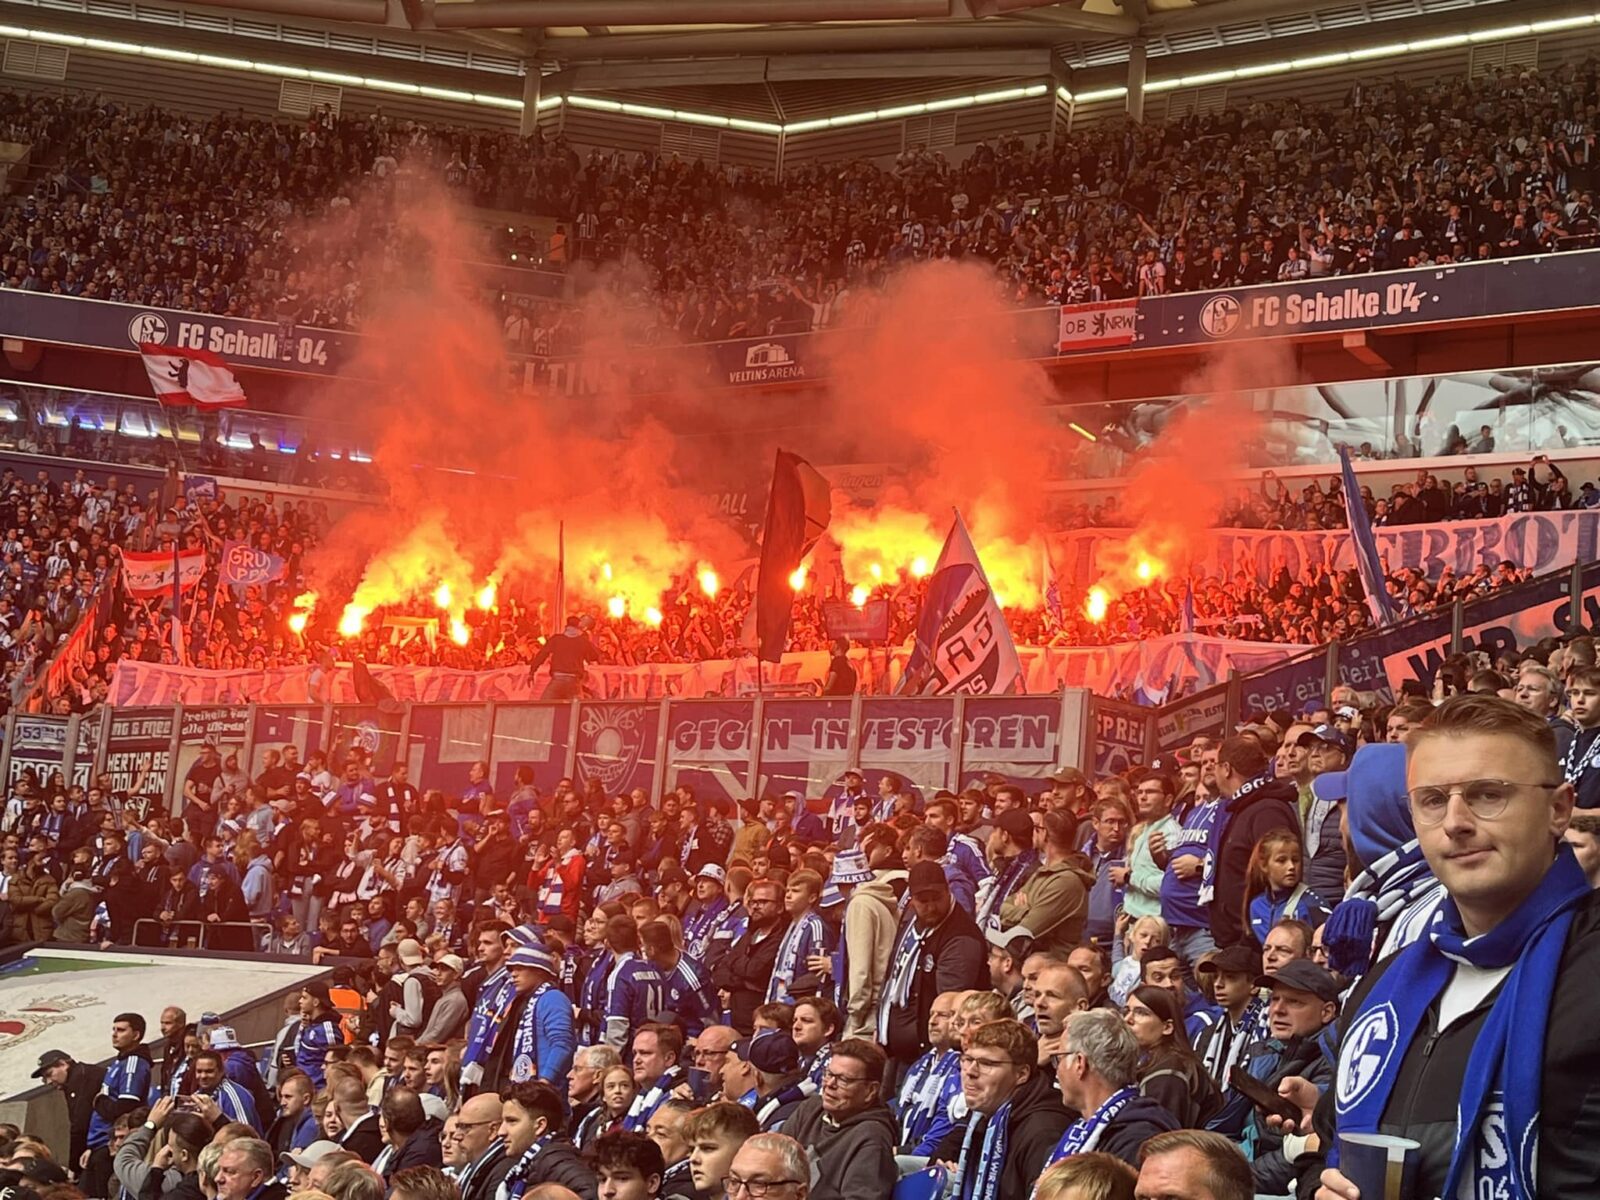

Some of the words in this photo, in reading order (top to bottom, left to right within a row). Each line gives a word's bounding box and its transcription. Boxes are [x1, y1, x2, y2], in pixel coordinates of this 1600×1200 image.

[1251, 295, 1280, 328] FC
[1285, 288, 1380, 325] Schalke
[1386, 282, 1421, 315] 04
[1065, 319, 1087, 335] OB
[1105, 315, 1134, 331] NRW
[177, 321, 204, 351] FC
[296, 337, 328, 366] 04
[729, 369, 768, 383] VELTINS
[767, 366, 805, 380] ARENA
[229, 547, 266, 569] GRU
[1247, 686, 1290, 713] Sei
[152, 751, 170, 771] BS
[521, 996, 539, 1054] SCHALKE
[1479, 1175, 1510, 1200] 04
